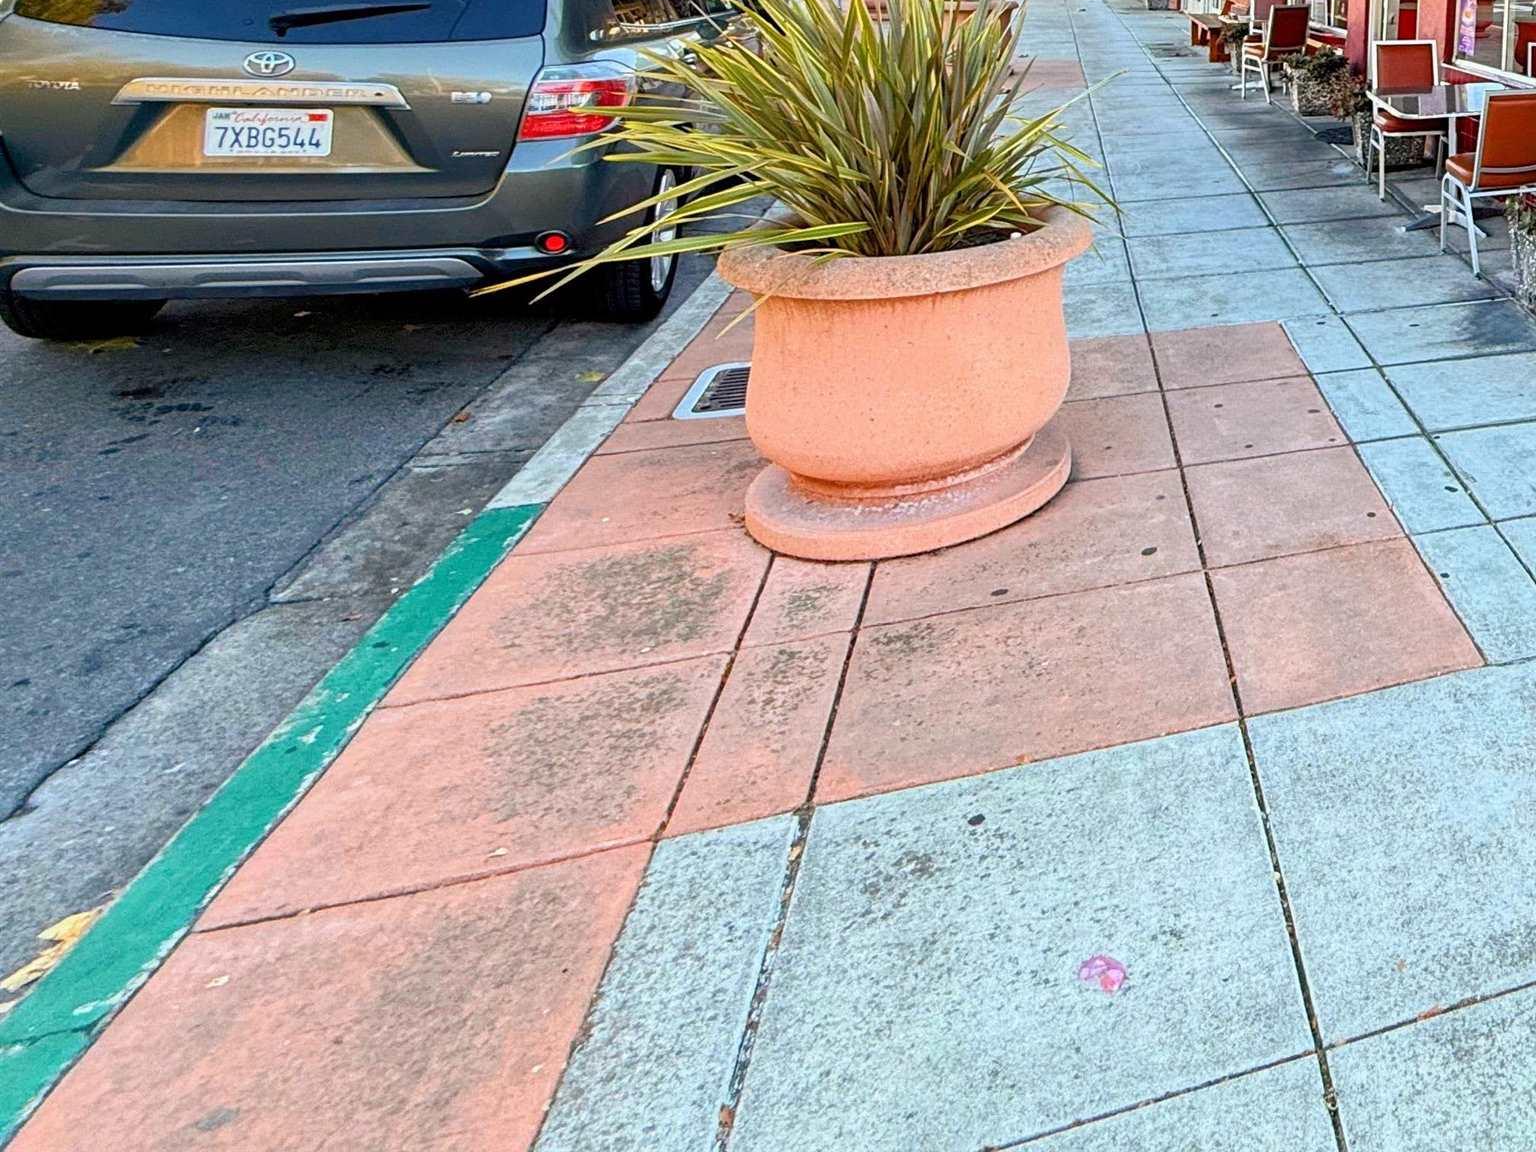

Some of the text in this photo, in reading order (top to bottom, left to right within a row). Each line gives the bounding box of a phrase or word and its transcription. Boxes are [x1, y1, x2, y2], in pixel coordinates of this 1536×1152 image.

[146, 83, 367, 98] HIGHLANDER
[233, 111, 303, 126] California
[214, 126, 322, 149] 7XBG544
